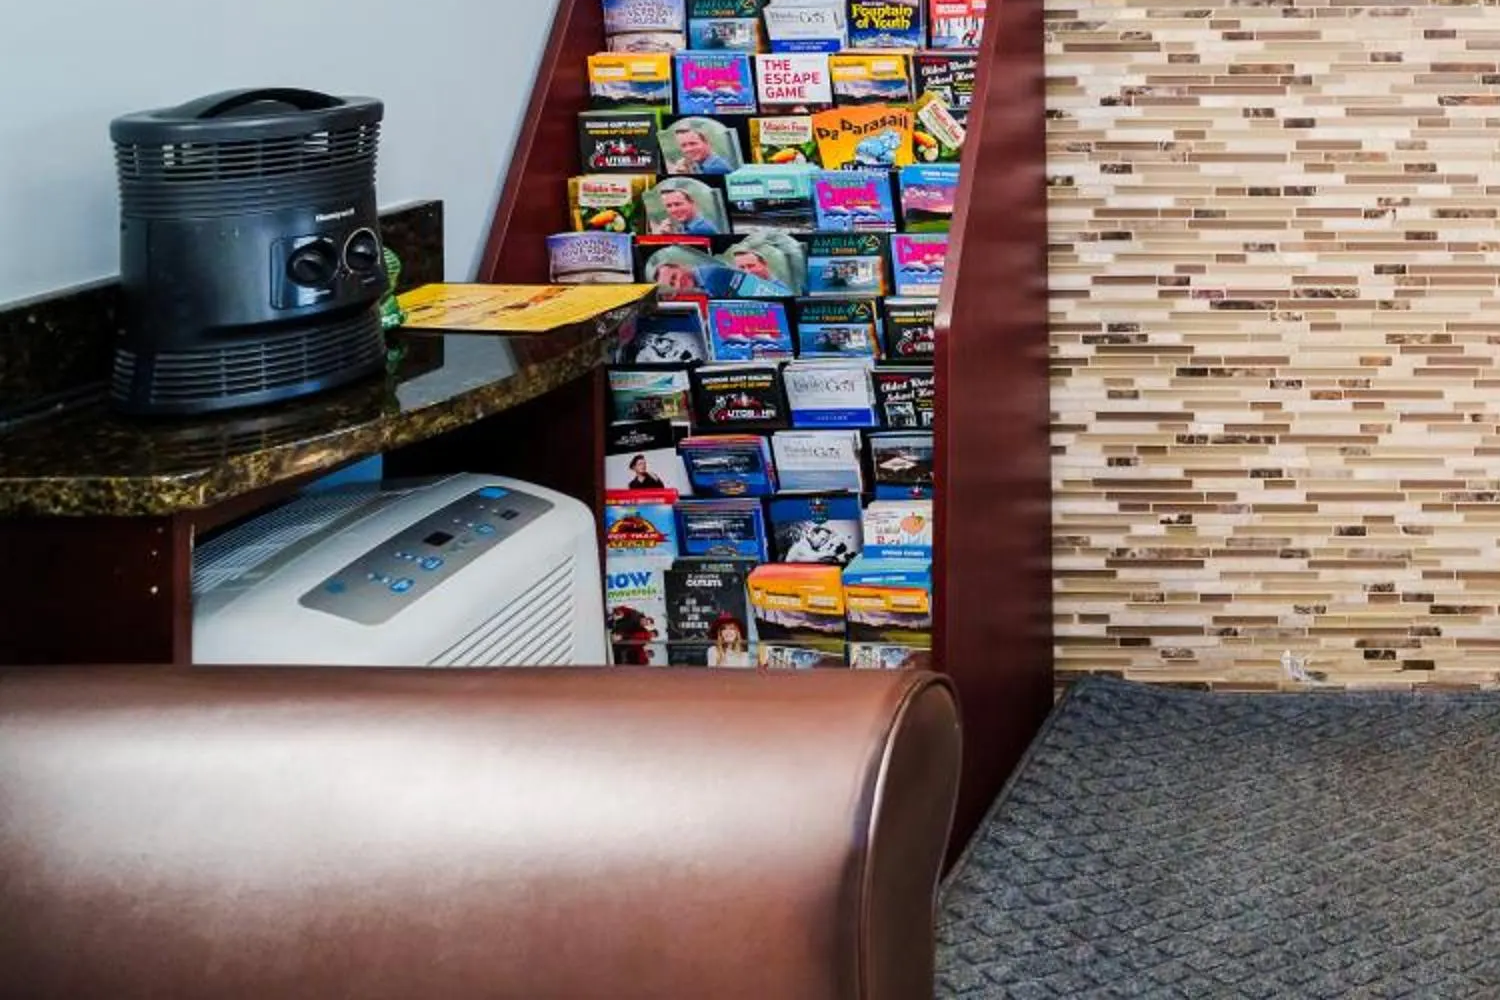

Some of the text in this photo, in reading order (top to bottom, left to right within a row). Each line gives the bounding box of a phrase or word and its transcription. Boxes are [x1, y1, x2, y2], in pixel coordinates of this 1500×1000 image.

[852, 1, 913, 20] Fountain
[856, 14, 911, 30] of Youth
[764, 59, 791, 72] THE
[764, 72, 821, 85] ESCAPE
[765, 86, 807, 99] GAME
